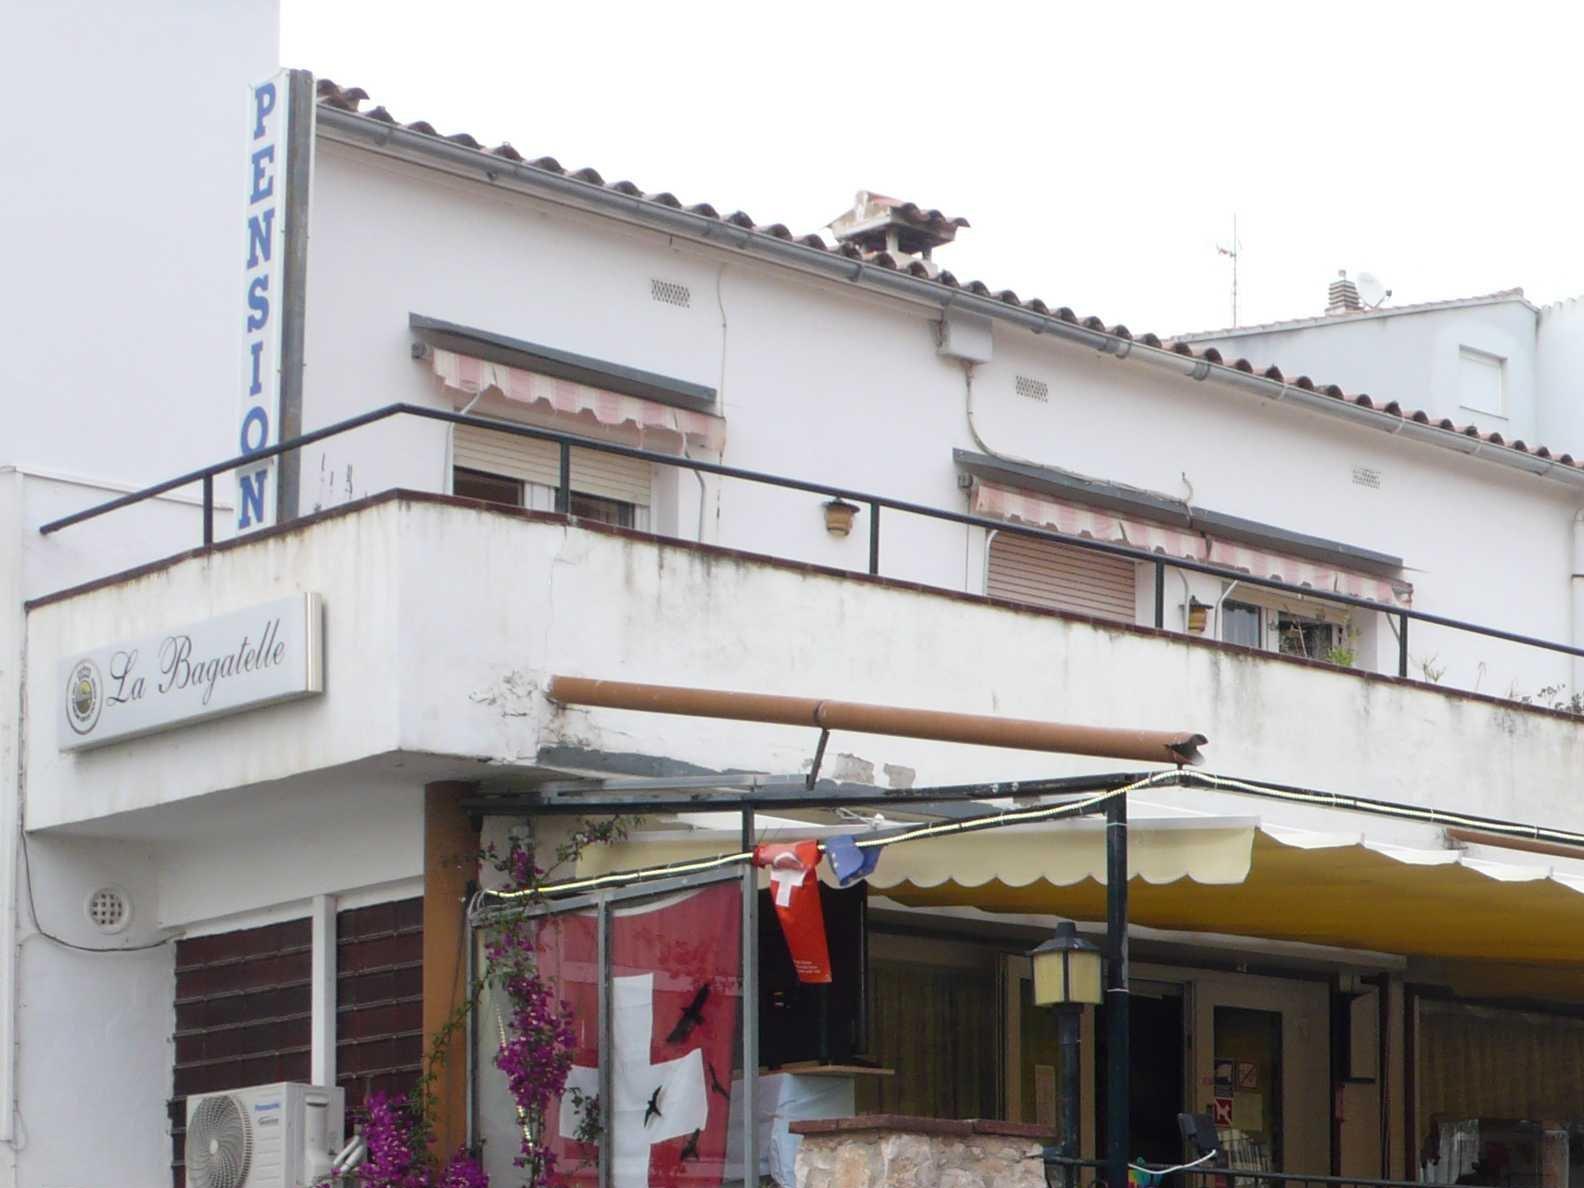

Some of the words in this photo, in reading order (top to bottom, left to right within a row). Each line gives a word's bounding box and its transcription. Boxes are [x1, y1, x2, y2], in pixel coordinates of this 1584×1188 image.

[238, 82, 276, 529] PENSION
[106, 649, 145, 706] La
[158, 617, 285, 705] Bagatelle
